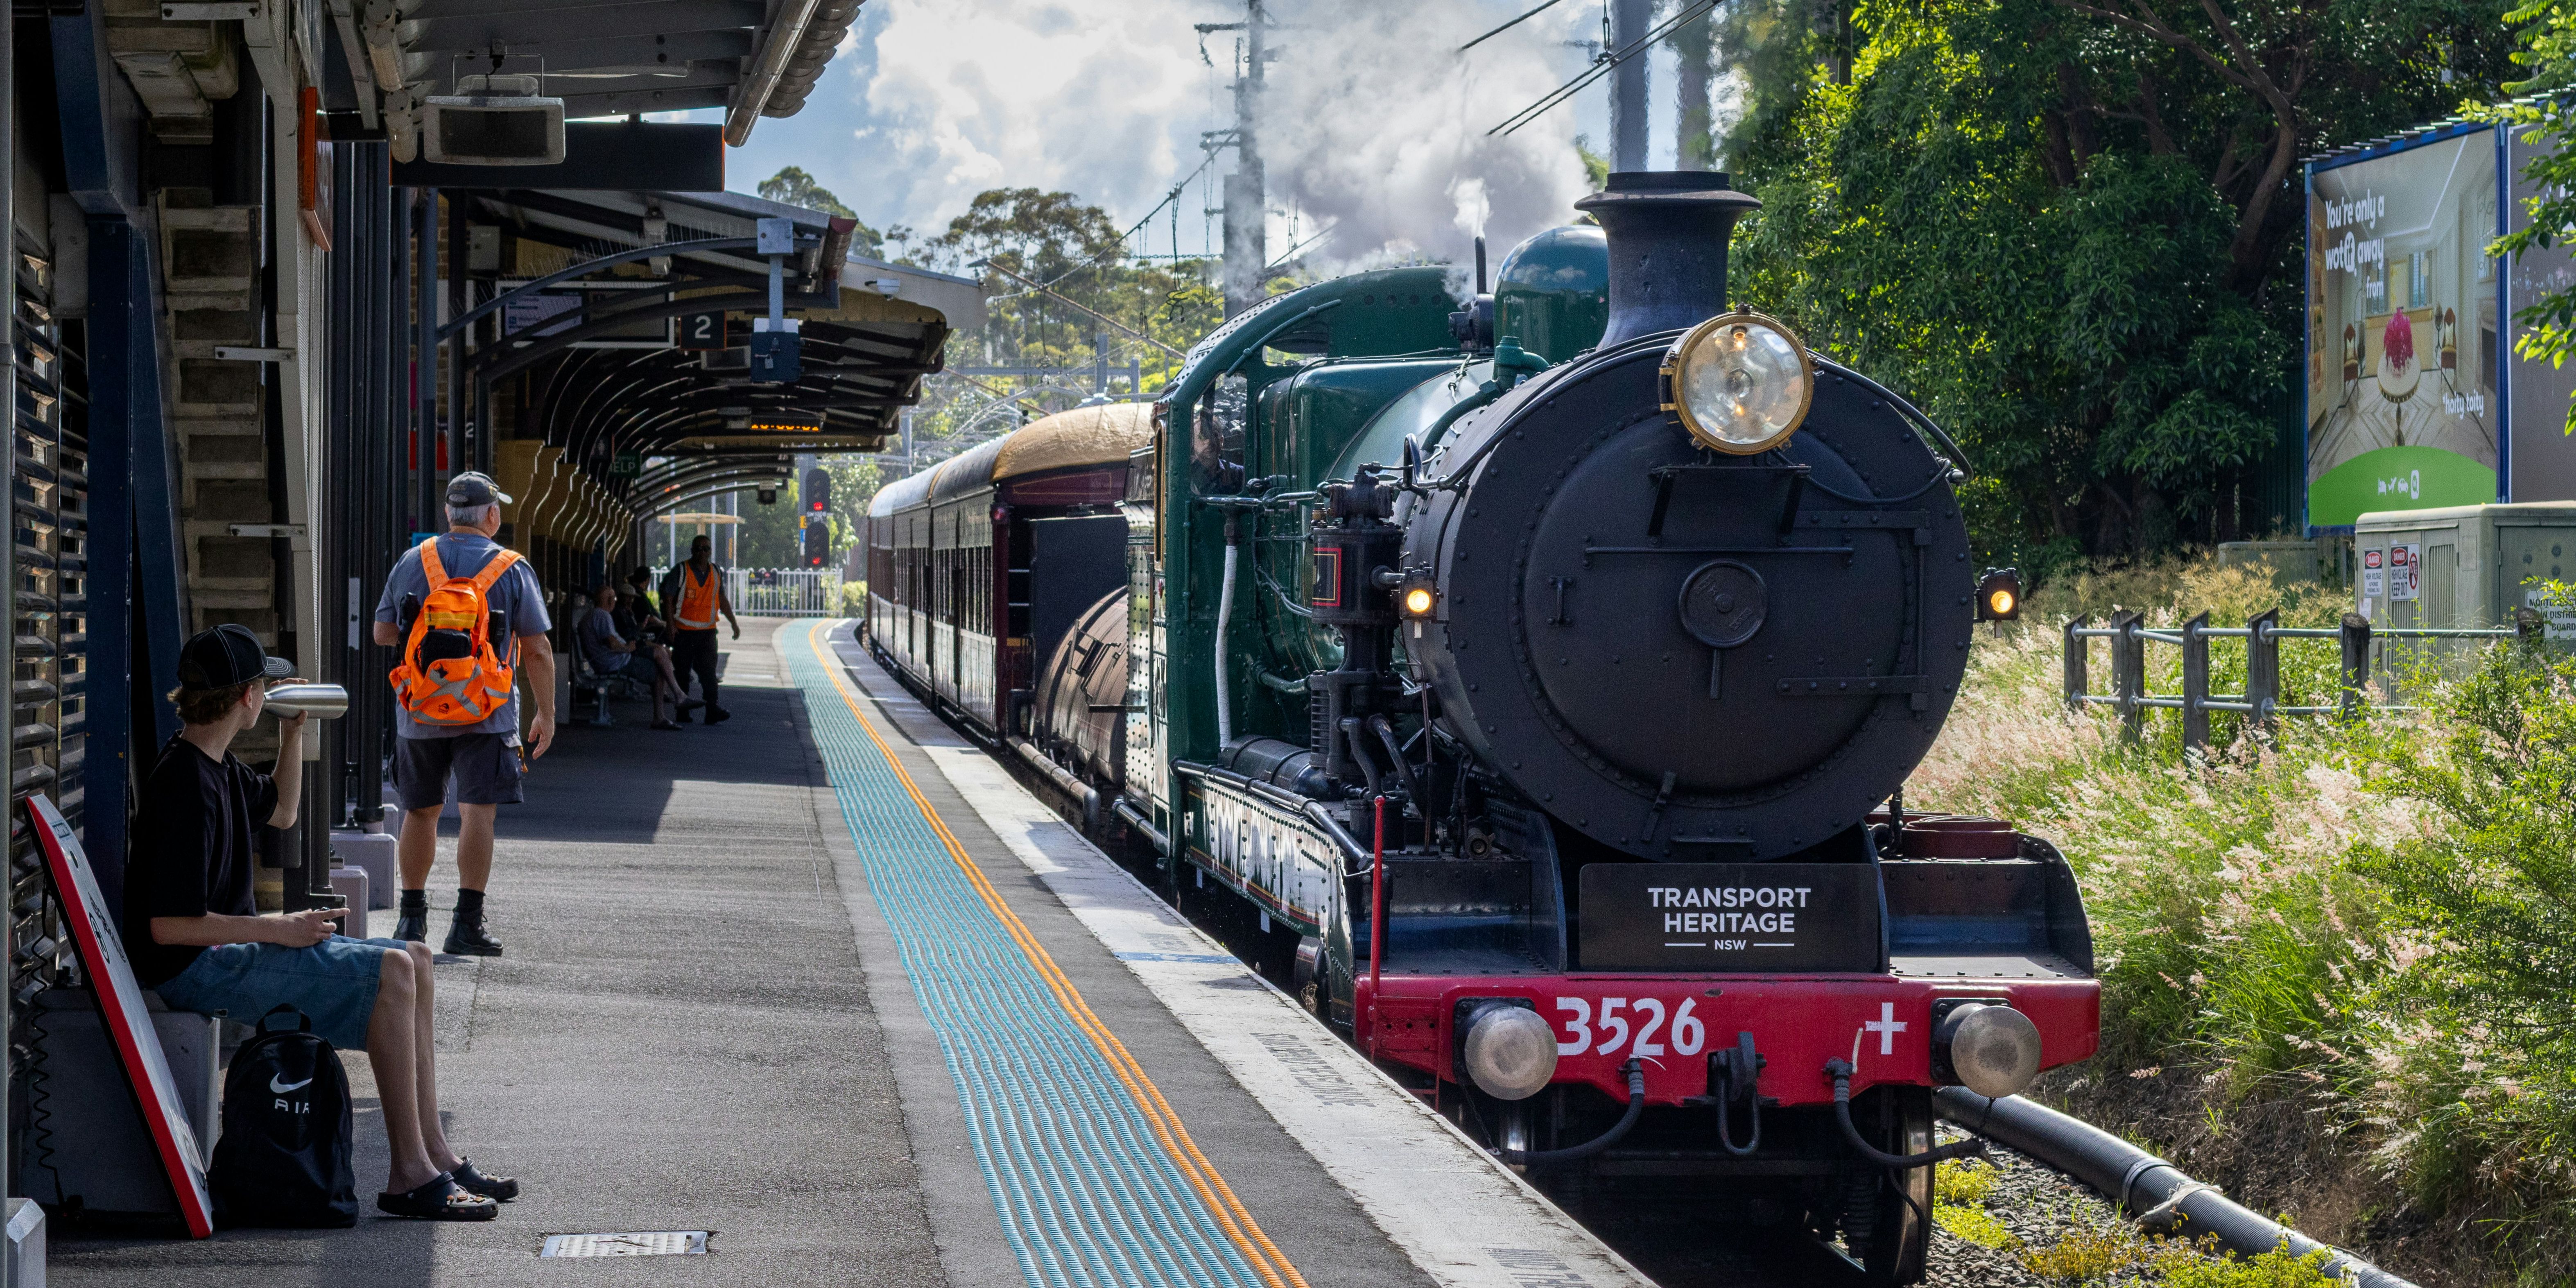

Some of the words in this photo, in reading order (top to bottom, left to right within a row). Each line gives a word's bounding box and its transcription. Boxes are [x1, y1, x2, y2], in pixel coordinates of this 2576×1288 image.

[2325, 197, 2353, 229] You're
[2355, 188, 2376, 229] only
[2378, 195, 2384, 217] a
[2357, 238, 2384, 270] away
[2366, 276, 2384, 298] from
[695, 316, 711, 339] 2
[2466, 389, 2484, 418] toity
[2368, 555, 2379, 564] DANGER
[2394, 552, 2405, 561] DANGER
[2392, 582, 2400, 596] KEEP
[1648, 888, 1811, 907] TRANSPORT
[1665, 913, 1794, 933] HERITAGE
[1715, 940, 1747, 950] NSW
[1557, 996, 1705, 1056] 3526
[275, 1098, 309, 1114] AIR
